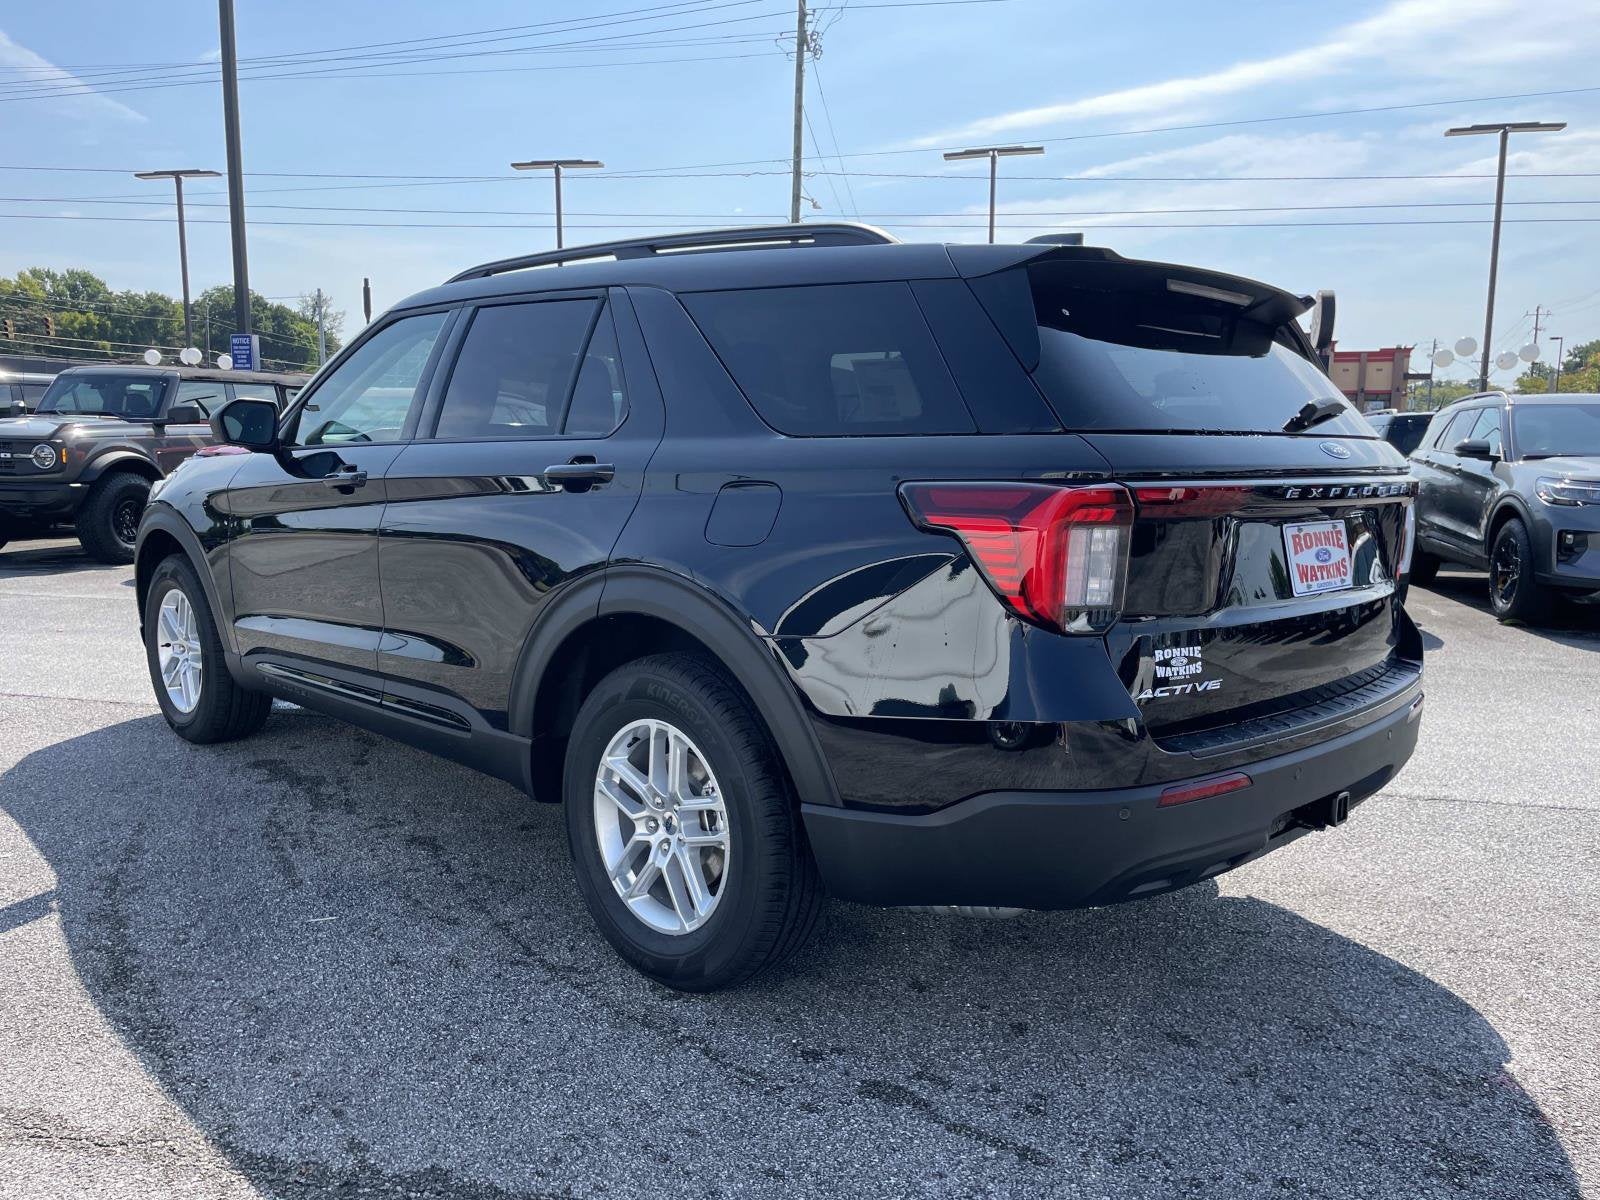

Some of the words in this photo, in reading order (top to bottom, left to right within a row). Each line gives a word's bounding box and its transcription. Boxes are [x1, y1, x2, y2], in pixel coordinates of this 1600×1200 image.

[232, 337, 250, 345] NOTICE
[1286, 483, 1408, 499] EXPLORER
[1291, 529, 1345, 556] RONNIE
[1296, 557, 1348, 584] WATKINS
[1154, 646, 1202, 662] RONNIE
[1155, 661, 1202, 678] WATKINS
[1135, 679, 1223, 700] ACTIVE
